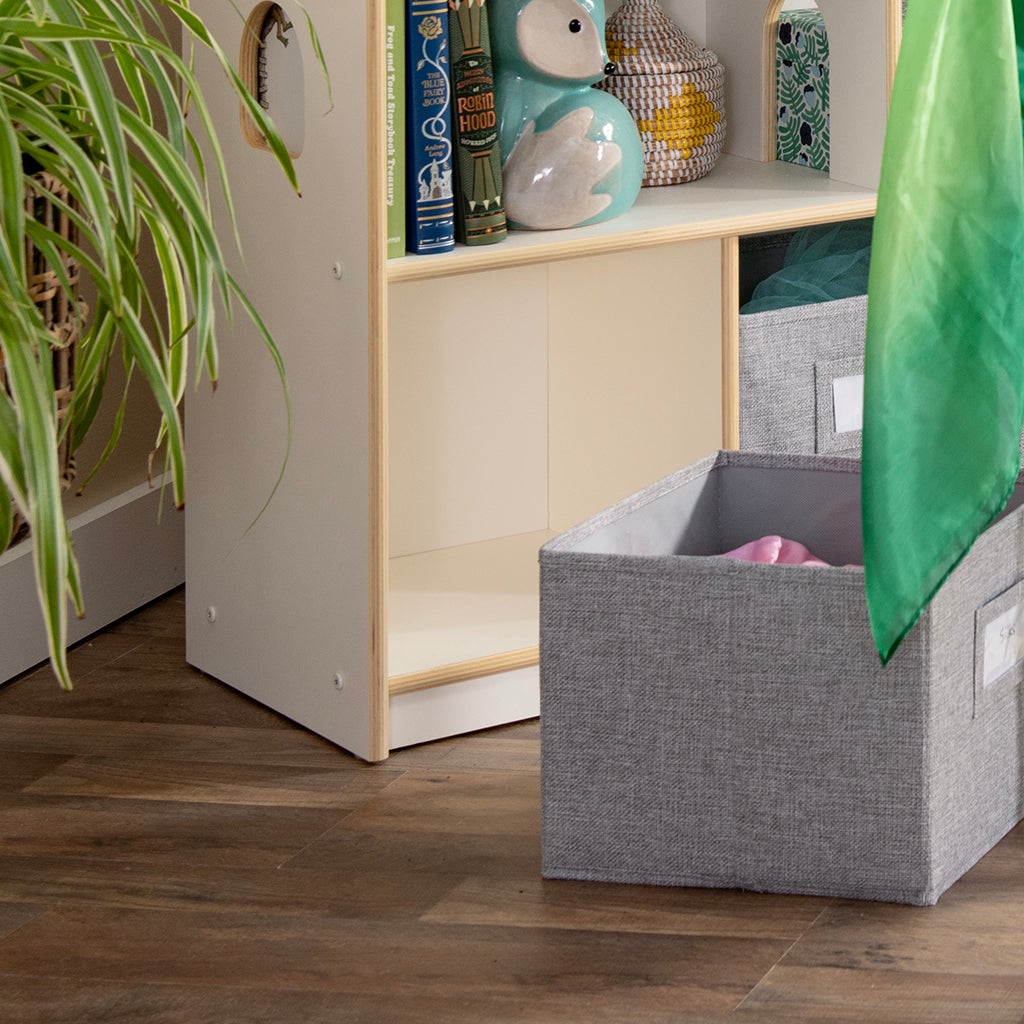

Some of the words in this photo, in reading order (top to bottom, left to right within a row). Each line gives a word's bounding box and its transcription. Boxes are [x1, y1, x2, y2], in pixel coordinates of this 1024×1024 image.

[387, 25, 396, 50] Frog
[387, 52, 396, 72] and
[387, 74, 396, 99] Toad
[421, 79, 445, 89] BLUE
[422, 96, 446, 107] BOOK
[386, 102, 396, 155] Storybook
[459, 110, 496, 133] HOOD
[386, 158, 396, 207] Treasury
